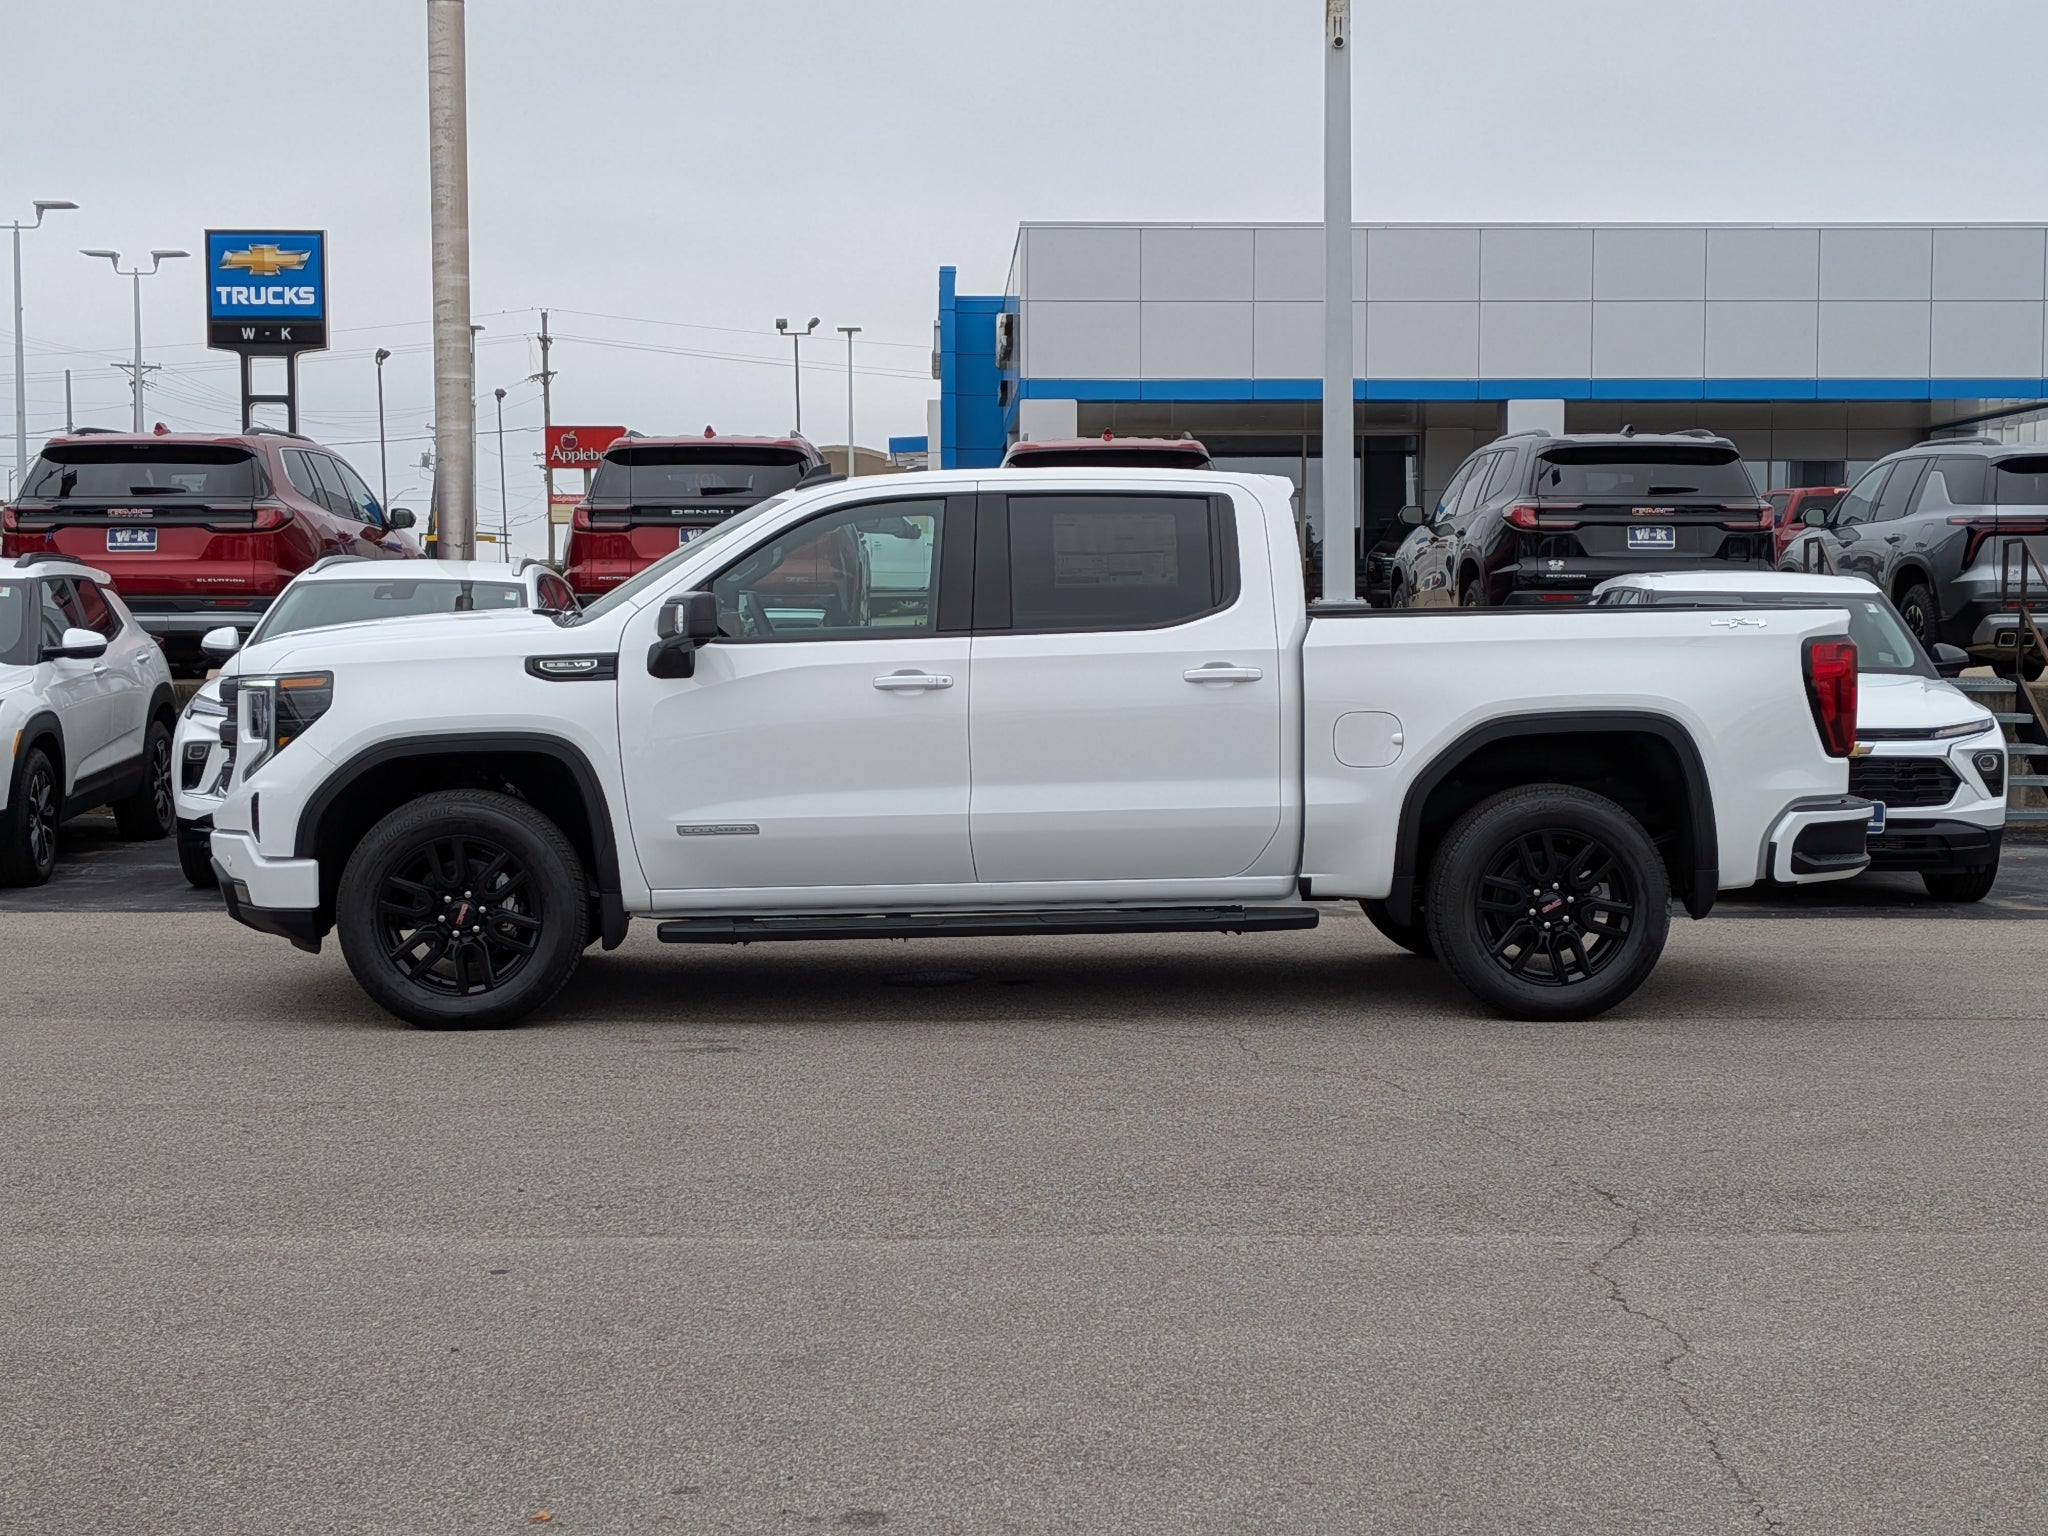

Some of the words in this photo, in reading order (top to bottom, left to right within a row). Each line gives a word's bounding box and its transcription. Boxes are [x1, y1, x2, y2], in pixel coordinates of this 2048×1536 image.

[216, 286, 315, 305] TRUCKS
[107, 508, 153, 518] GMC
[1631, 507, 1675, 516] GMC
[115, 529, 149, 543] W-K
[1635, 527, 1667, 540] W-K
